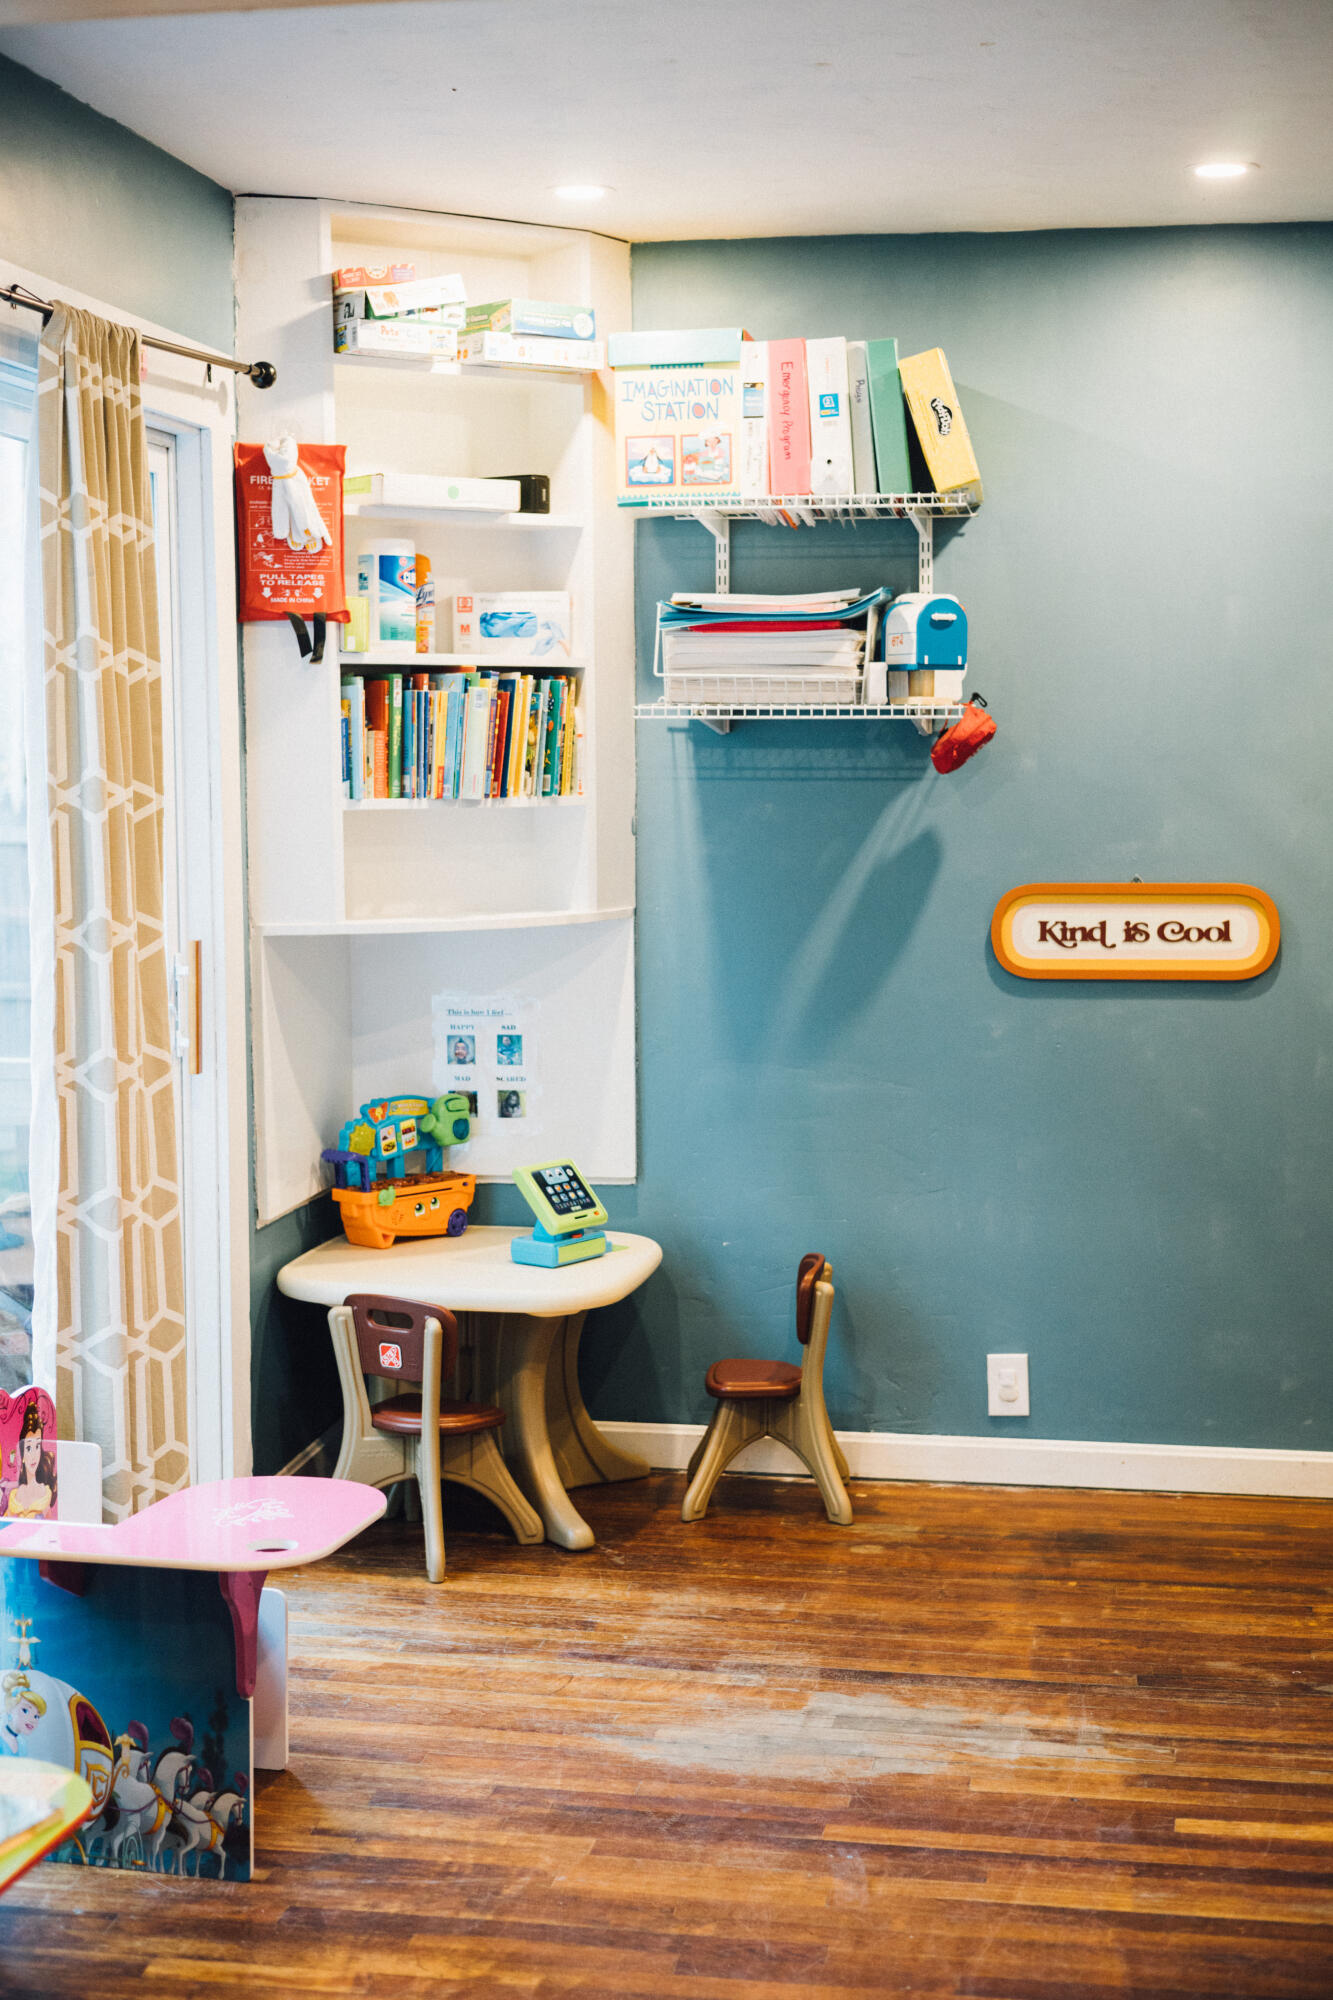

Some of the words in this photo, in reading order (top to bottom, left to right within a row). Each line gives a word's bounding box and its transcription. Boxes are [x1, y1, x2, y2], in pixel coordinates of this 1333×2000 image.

[621, 376, 735, 402] IMAGINATION
[641, 399, 719, 422] STATION
[779, 421, 794, 460] Program
[249, 475, 273, 485] FIRE
[460, 624, 470, 633] M
[1037, 919, 1116, 948] Kind
[1122, 920, 1150, 943] is
[1157, 920, 1232, 943] Cool
[448, 1008, 462, 1016] This
